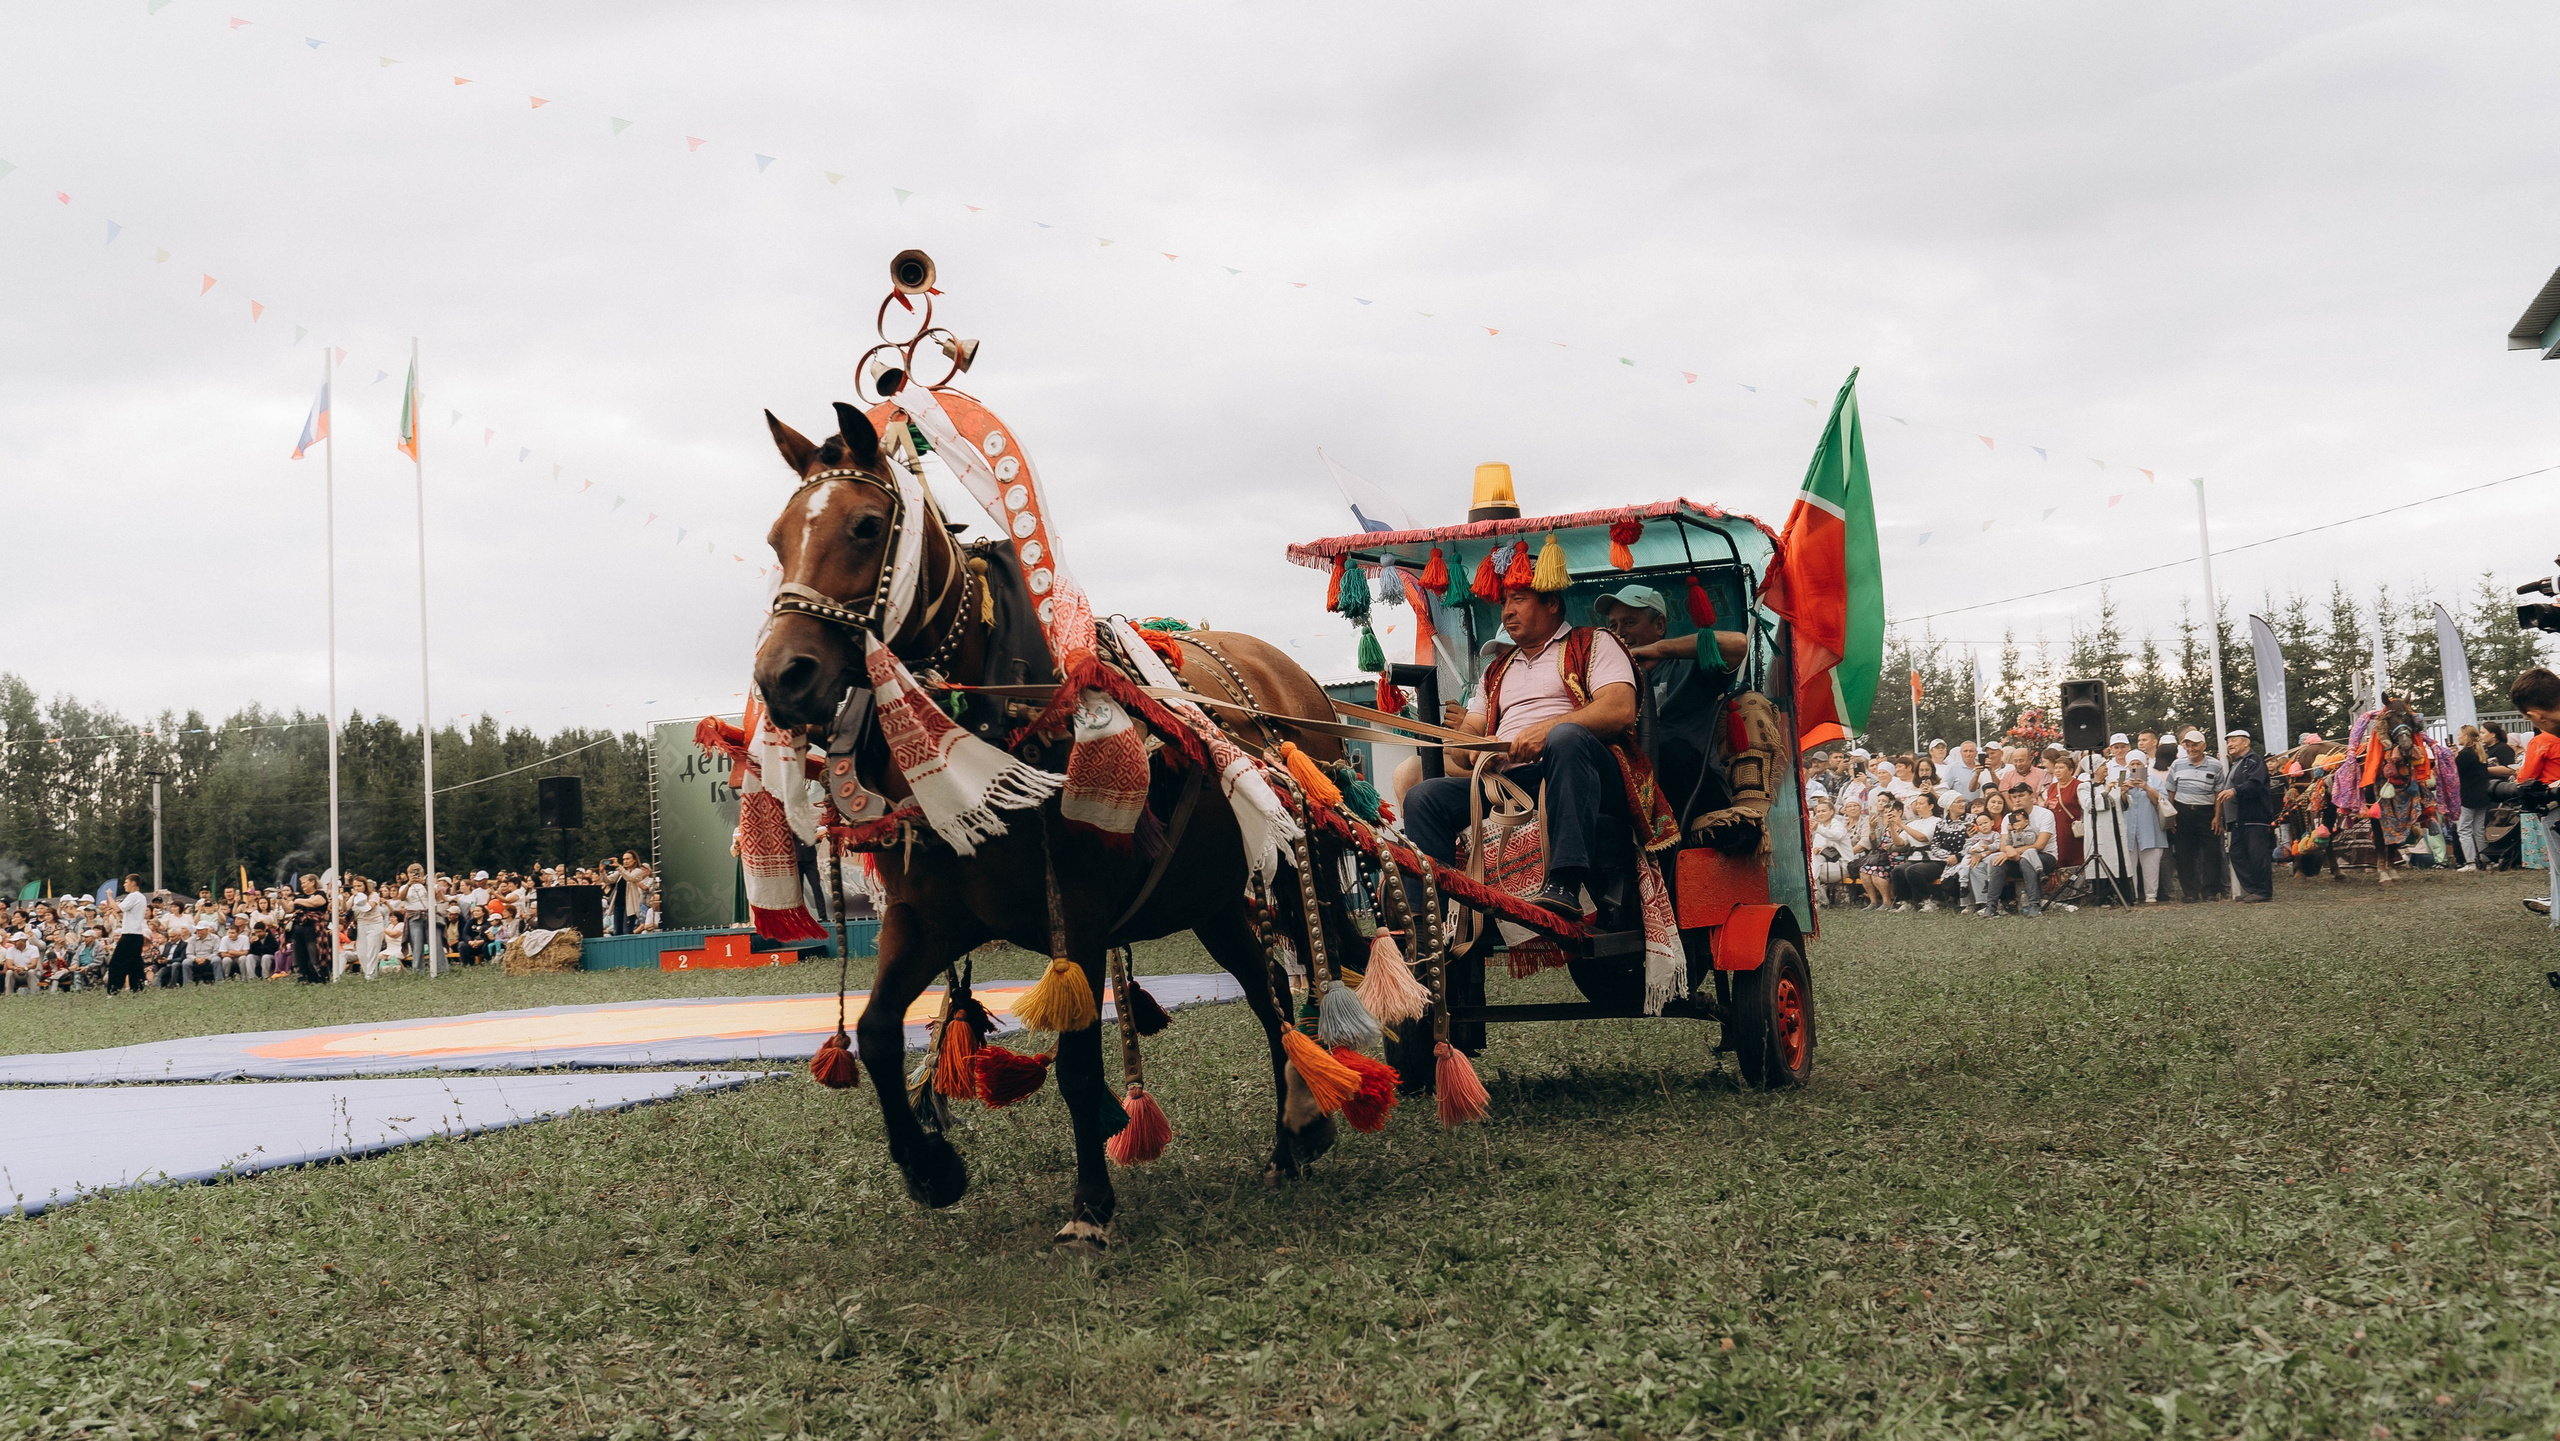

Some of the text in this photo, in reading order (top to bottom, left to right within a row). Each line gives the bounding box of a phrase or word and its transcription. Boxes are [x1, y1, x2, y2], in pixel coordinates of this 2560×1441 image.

[725, 943, 733, 957] 1
[678, 954, 688, 969] 2
[770, 953, 780, 967] 3
